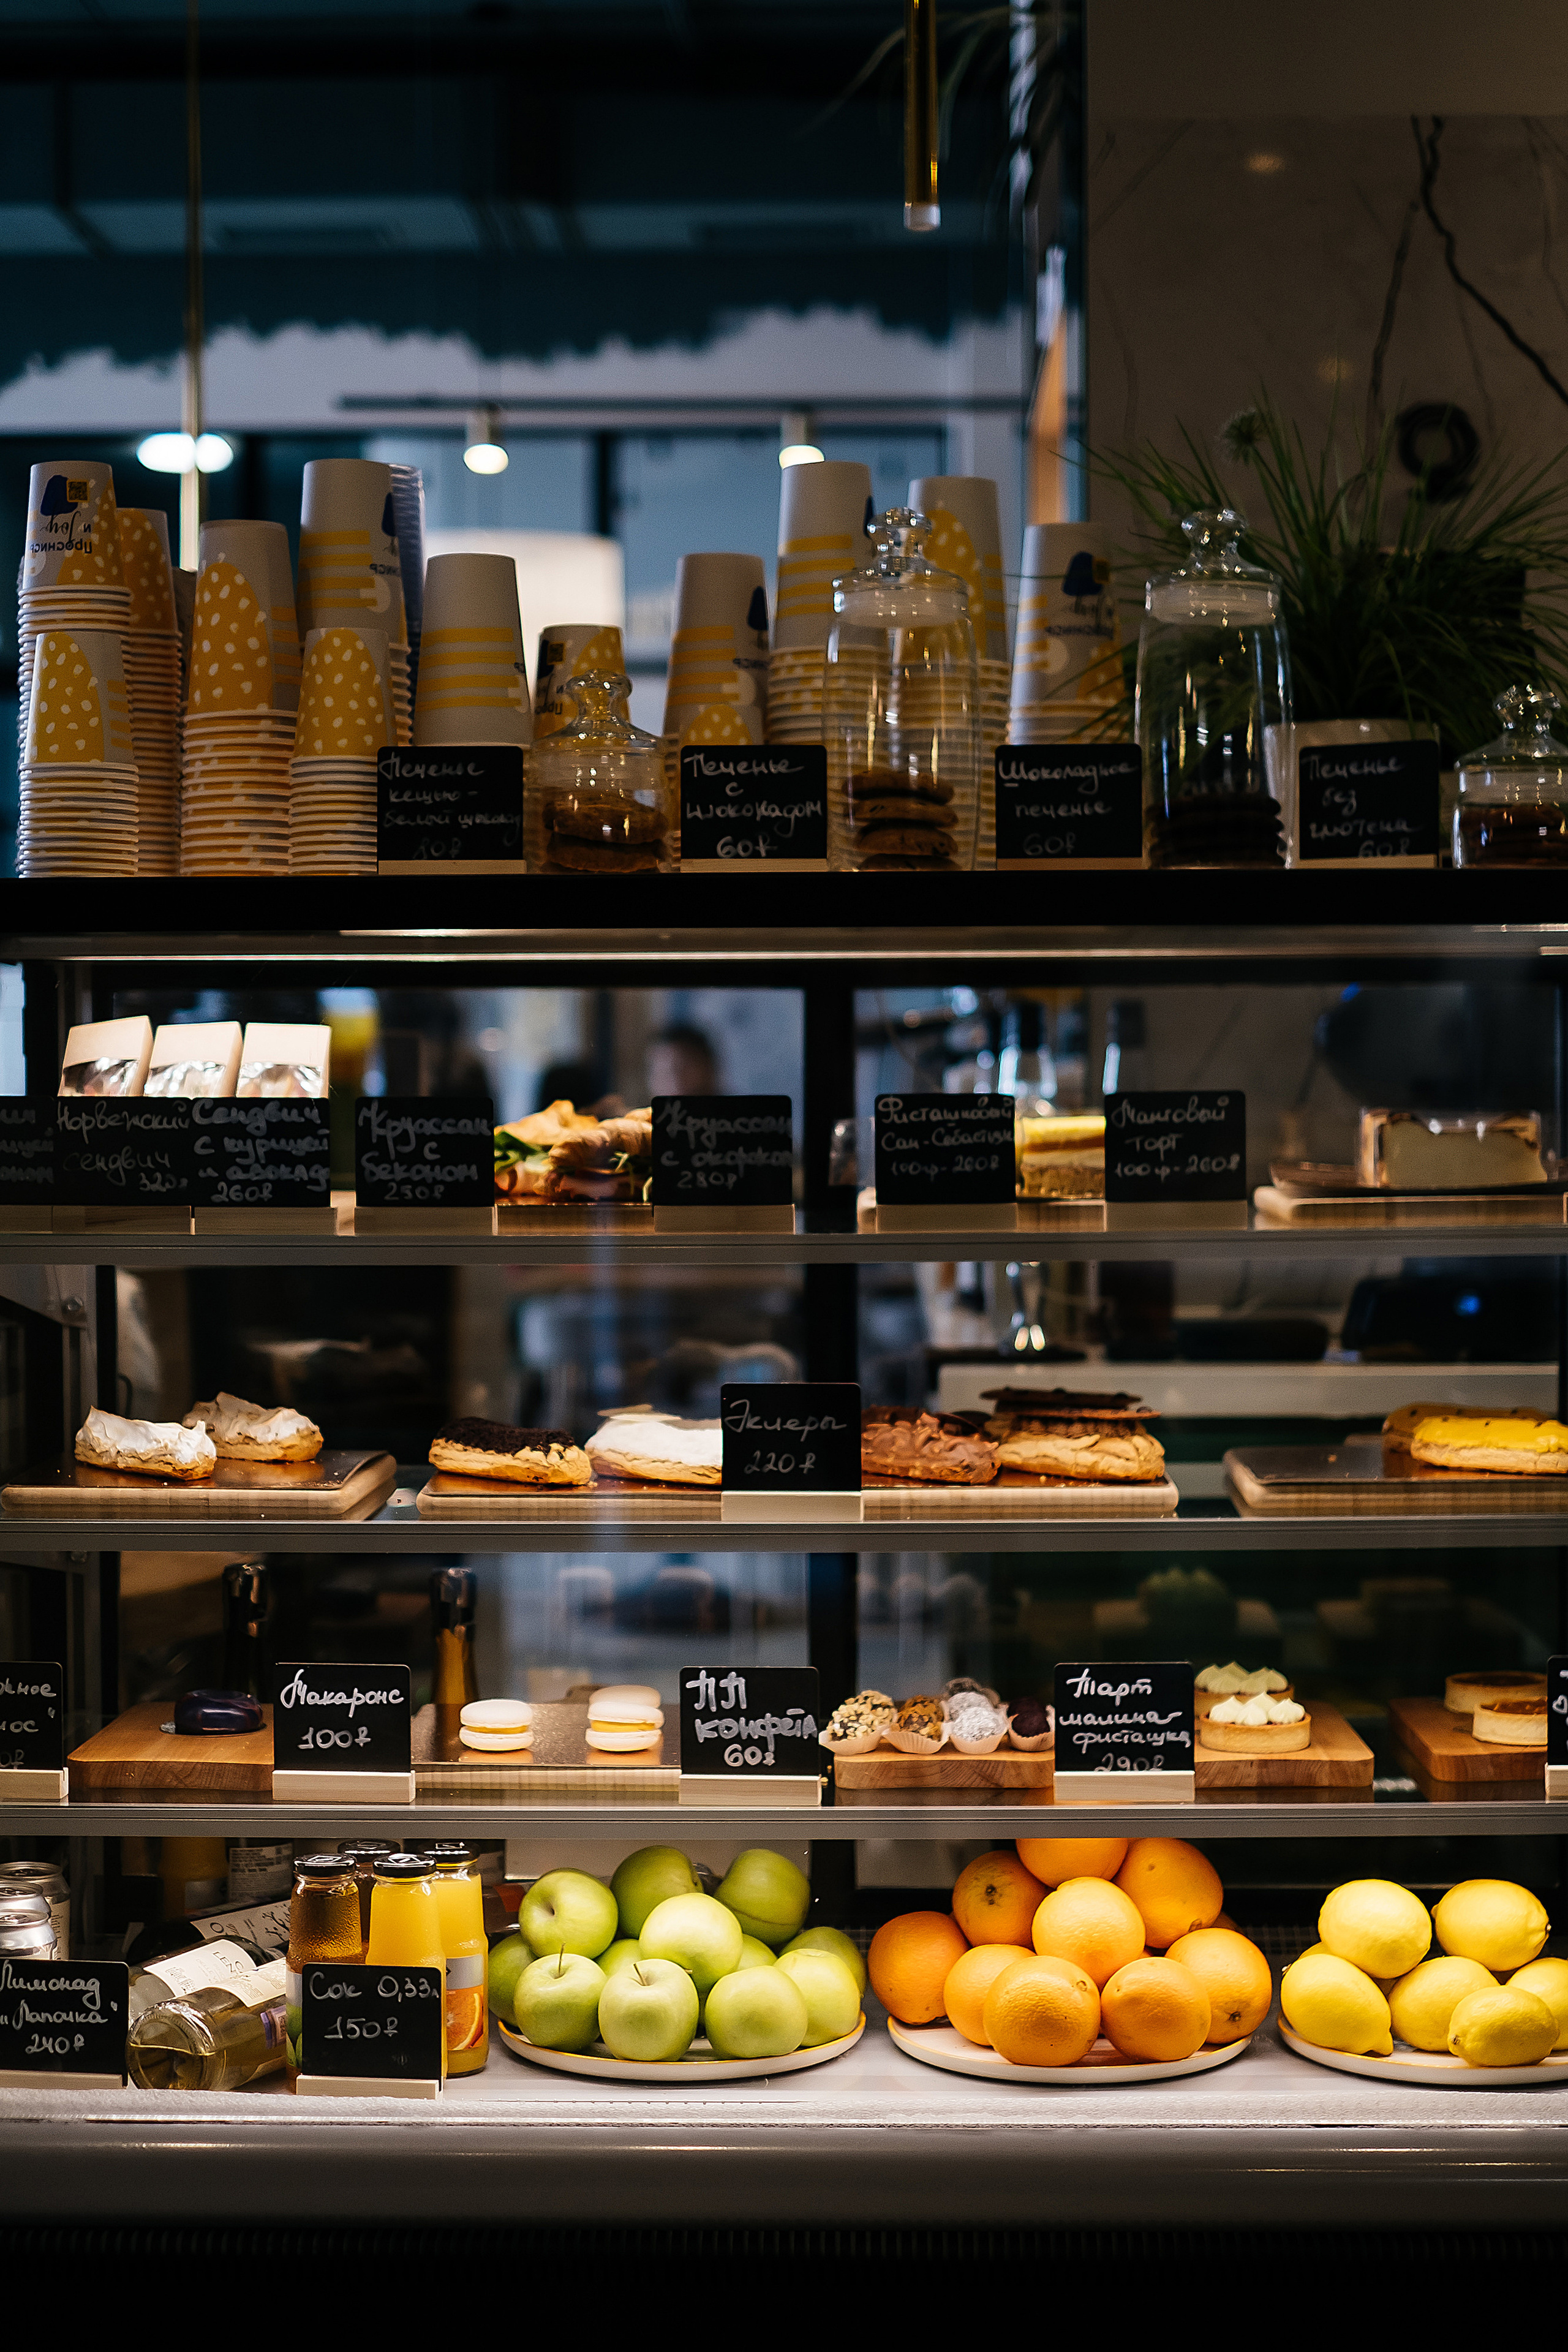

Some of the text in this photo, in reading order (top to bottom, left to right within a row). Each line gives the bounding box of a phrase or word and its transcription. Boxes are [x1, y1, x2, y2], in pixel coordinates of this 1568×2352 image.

[378, 752, 485, 780] Печенье
[684, 753, 805, 777] Печенье
[1300, 754, 1406, 781] Печенье
[1015, 801, 1112, 819] печенье
[1321, 786, 1357, 816] без
[358, 1099, 492, 1160] Круассан
[279, 1669, 404, 1718] Макаронс
[1066, 1668, 1152, 1707] Тарт
[297, 1726, 371, 1749] 100₽
[1072, 1730, 1192, 1754] фисташка
[0, 1959, 100, 2010] Лимонад
[309, 1971, 362, 1999] Сок
[324, 2016, 399, 2040] 150₽
[25, 2034, 85, 2054] 240₽
